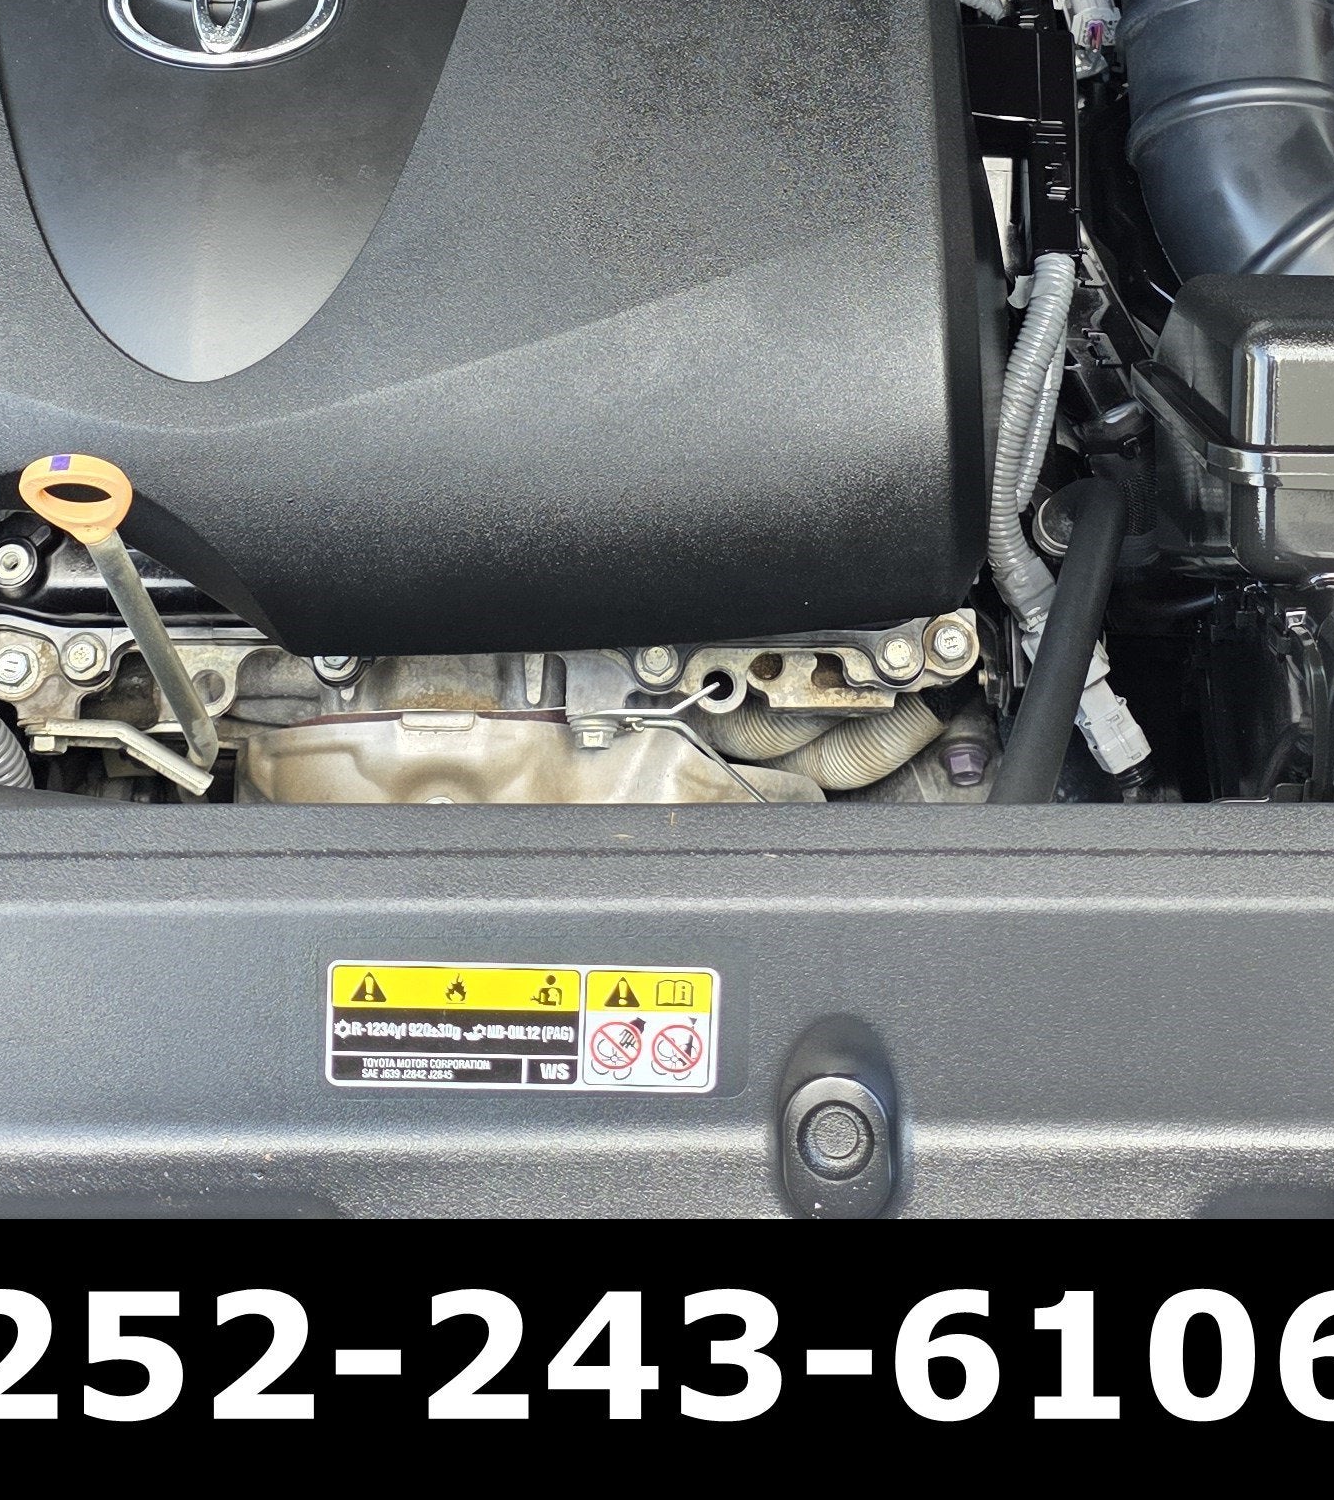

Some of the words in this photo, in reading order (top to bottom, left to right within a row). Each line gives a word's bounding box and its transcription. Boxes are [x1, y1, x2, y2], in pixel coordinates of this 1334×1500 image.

[351, 1021, 407, 1040] R-1234yf
[542, 1025, 574, 1043] (PAG)
[362, 1057, 396, 1068] TOYOTA
[397, 1058, 428, 1069] MOTOR
[430, 1059, 491, 1070] CORPORATION
[361, 1068, 378, 1078] SAE
[379, 1069, 400, 1079] J639
[540, 1063, 570, 1080] WS
